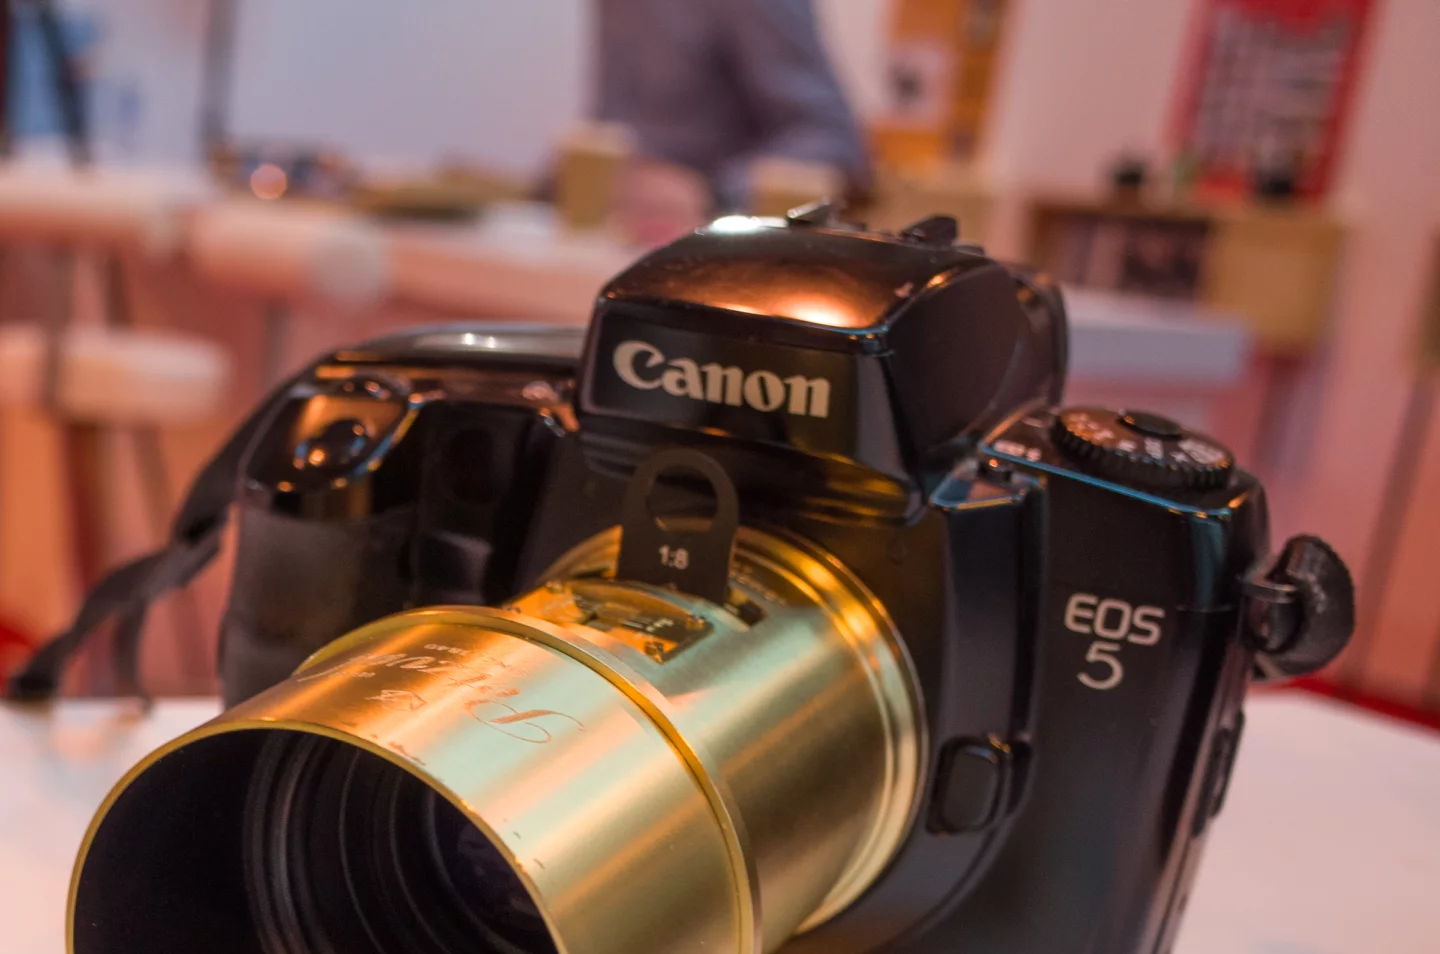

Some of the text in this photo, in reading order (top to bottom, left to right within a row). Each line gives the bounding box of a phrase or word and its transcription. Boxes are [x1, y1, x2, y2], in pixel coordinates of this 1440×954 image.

[613, 340, 831, 418] Canon
[659, 545, 689, 570] 1:8
[1064, 592, 1166, 646] EOS
[1077, 640, 1123, 690] 5
